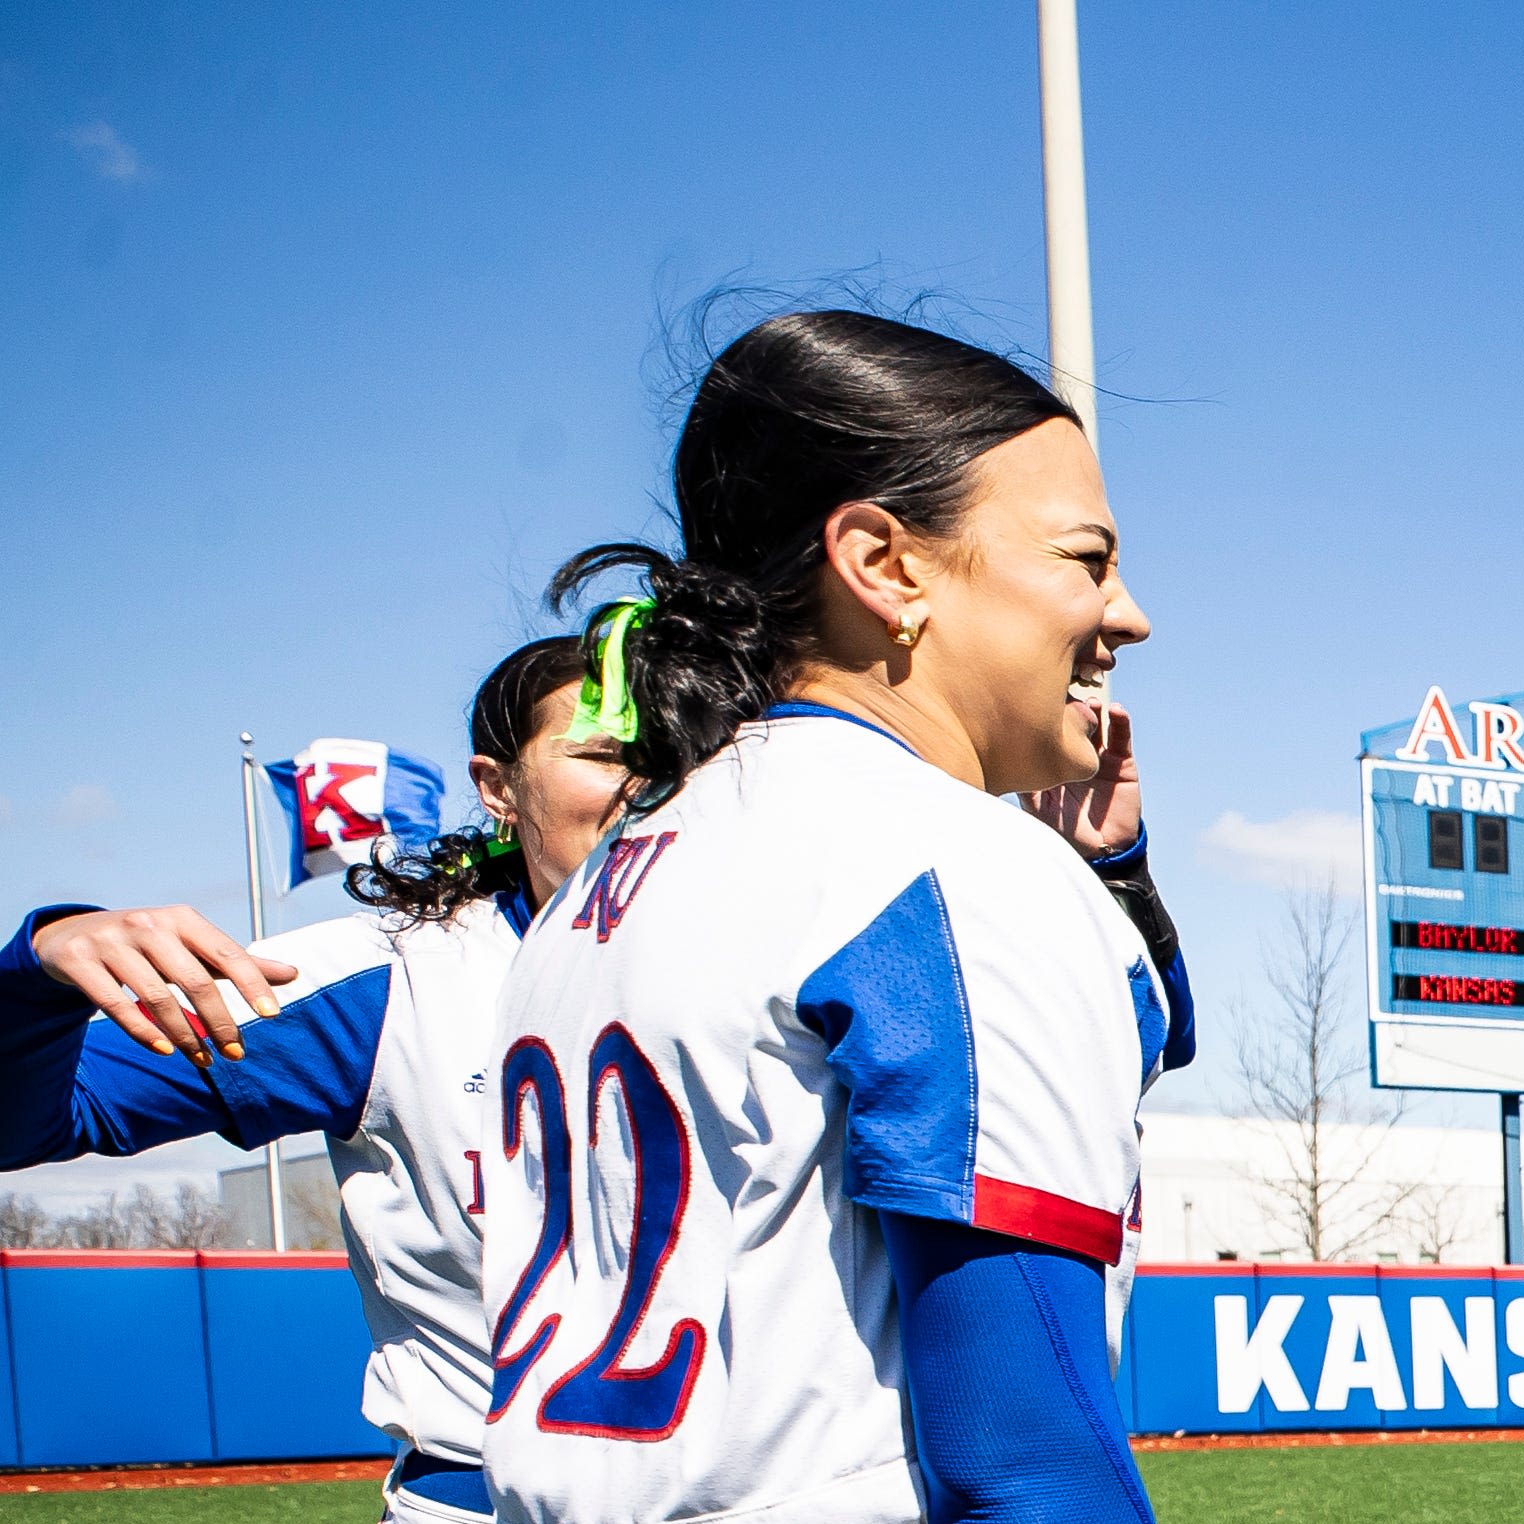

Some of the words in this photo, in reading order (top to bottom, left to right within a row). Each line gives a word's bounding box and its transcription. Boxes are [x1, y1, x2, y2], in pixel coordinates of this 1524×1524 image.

[296, 762, 383, 849] K
[1413, 774, 1454, 808] AT
[1460, 777, 1520, 815] BAT
[571, 831, 678, 943] KU
[1417, 921, 1518, 954] BAYLOR
[1419, 974, 1516, 1007] KANSAS
[486, 1021, 707, 1441] 22
